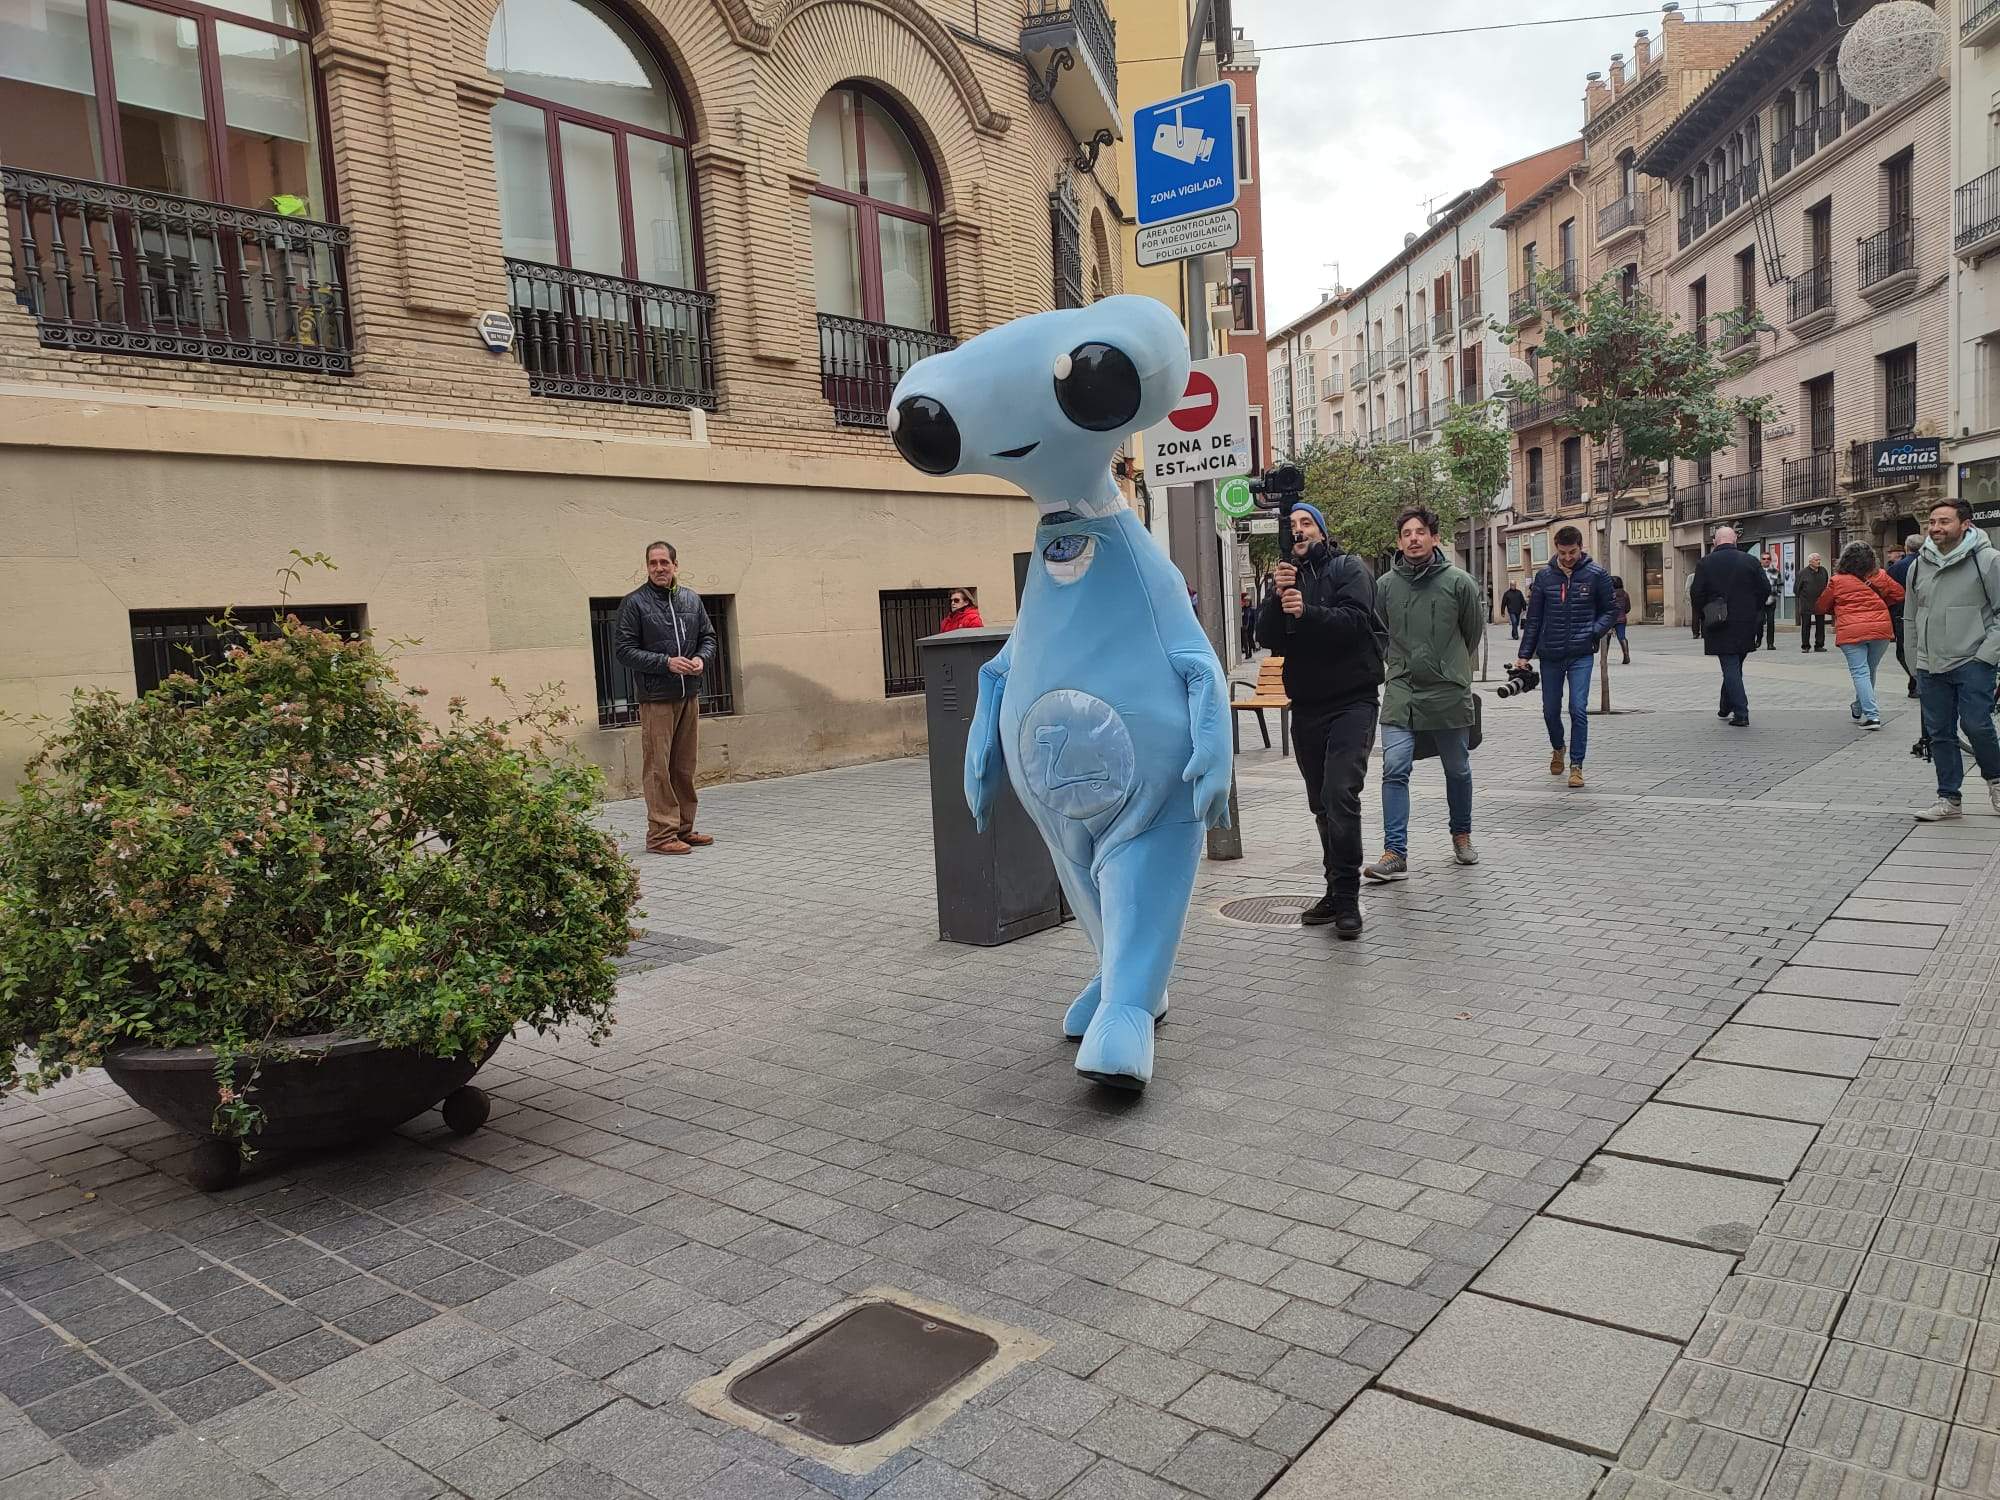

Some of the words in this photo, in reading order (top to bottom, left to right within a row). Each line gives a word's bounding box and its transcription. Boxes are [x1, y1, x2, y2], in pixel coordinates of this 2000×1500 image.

[1150, 190, 1176, 204] ZONA
[1178, 177, 1222, 196] VIGILADA
[1169, 215, 1227, 234] CONTROLADA
[1142, 237, 1159, 249] POR
[1161, 223, 1232, 245] VIDEOVIGILANCIA
[1156, 246, 1188, 259] POLICÍA
[1190, 240, 1218, 252] LOCAL
[1157, 438, 1202, 457] ZONA
[1211, 433, 1232, 449] DE
[1877, 451, 1938, 466] Arenas
